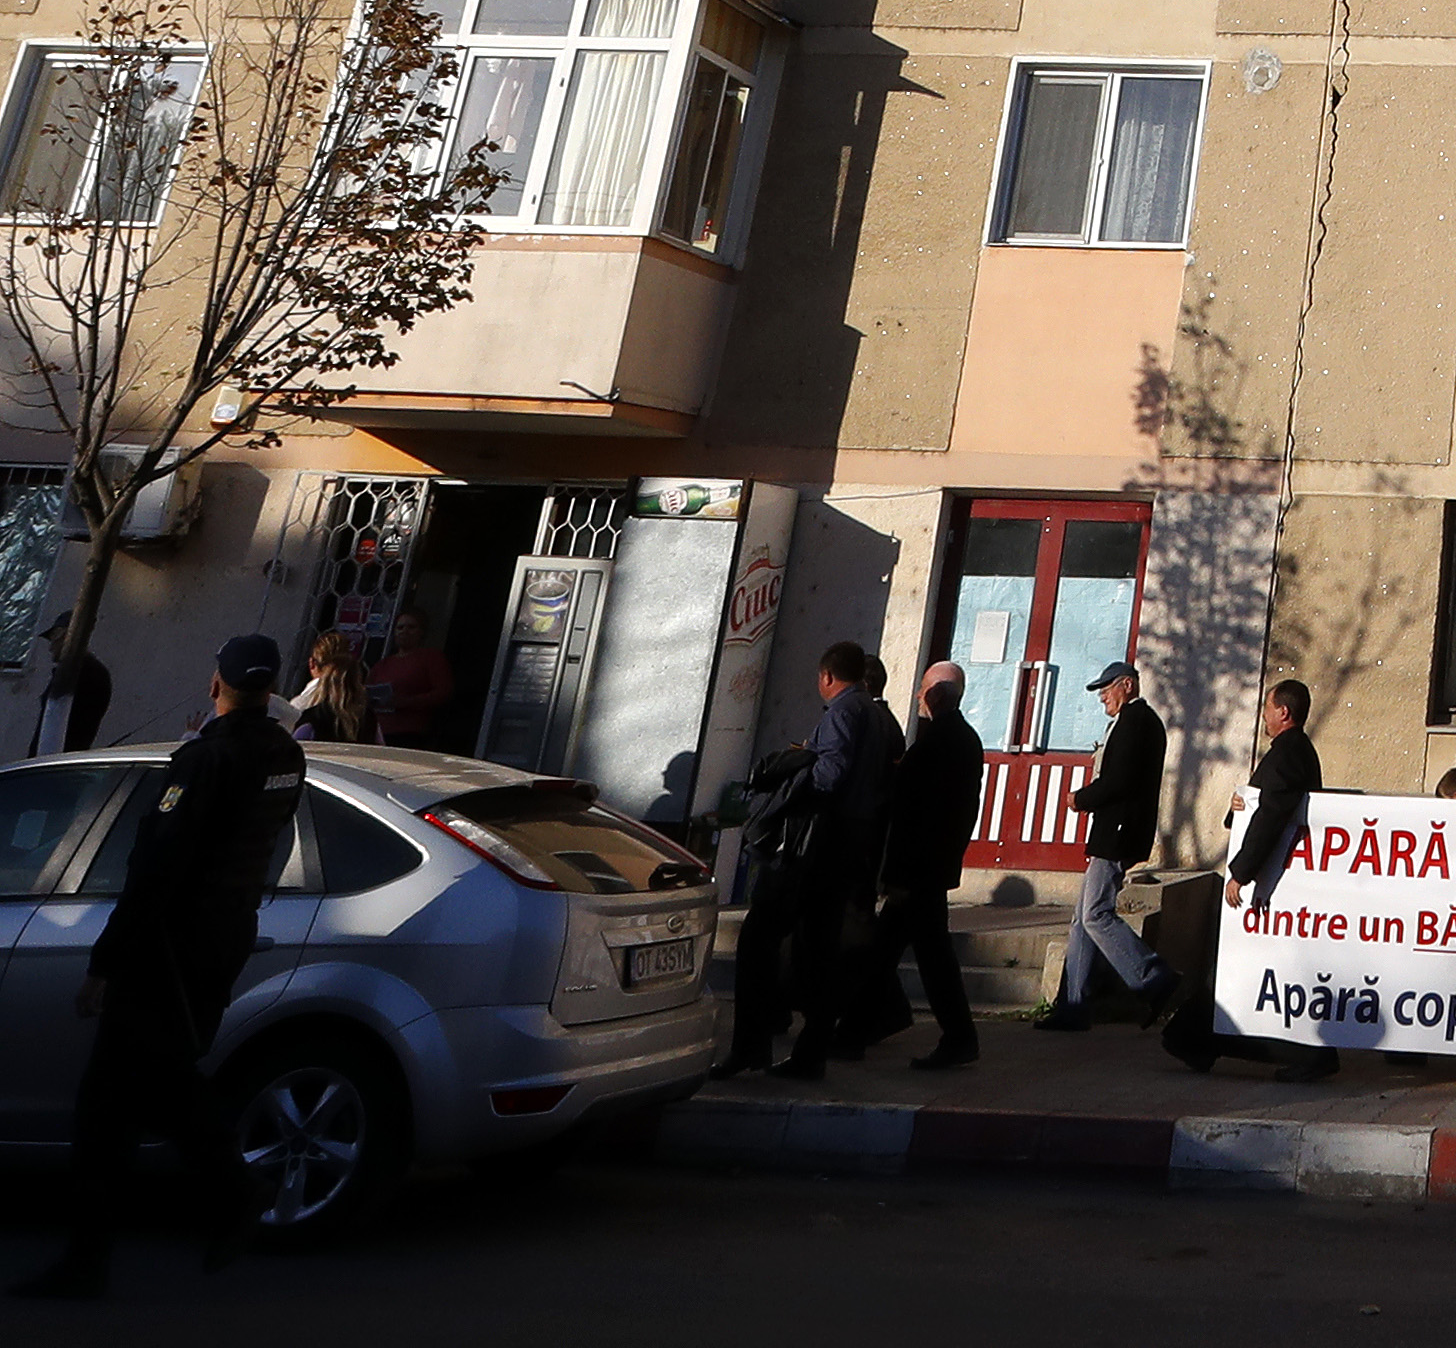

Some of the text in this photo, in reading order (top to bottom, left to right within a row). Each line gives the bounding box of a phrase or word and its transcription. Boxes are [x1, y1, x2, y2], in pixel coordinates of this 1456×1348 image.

[730, 575, 781, 632] Ciuc
[1283, 819, 1450, 880] APĂRĂ
[1243, 904, 1348, 941] dintre
[1359, 916, 1404, 944] un
[1255, 968, 1380, 1029] Apără
